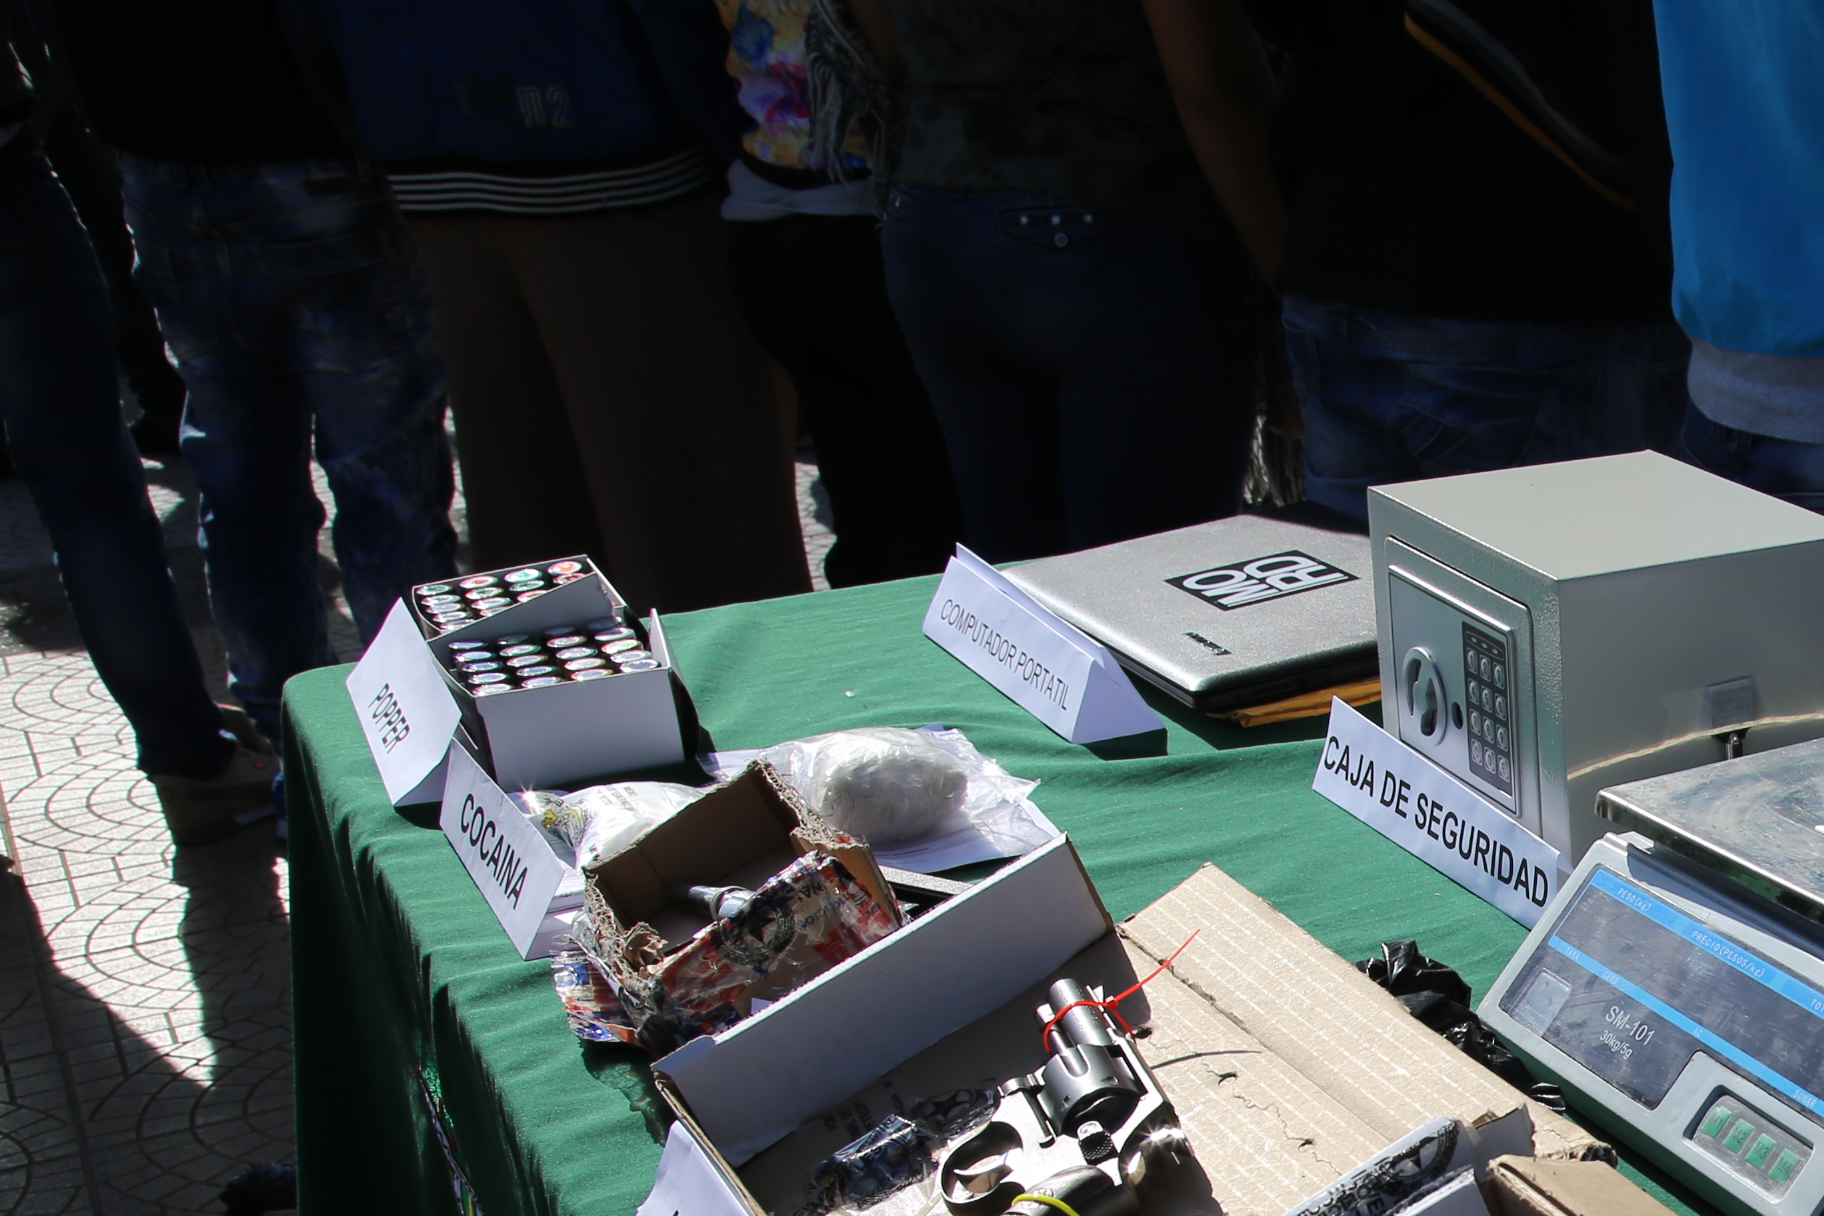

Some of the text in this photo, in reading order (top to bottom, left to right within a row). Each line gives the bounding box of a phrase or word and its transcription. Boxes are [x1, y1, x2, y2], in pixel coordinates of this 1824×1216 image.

[940, 598, 1070, 712] COMPUTADOR PORTATIL
[368, 682, 411, 755] POPPER
[460, 792, 529, 911] COCAINA
[1323, 735, 1549, 908] CAJA DE SEGURIDAD
[1616, 886, 1653, 912] PESO(kg)
[1691, 930, 1767, 978] PRECIO(PESOS/kg)
[1599, 1029, 1634, 1061] 30kg/5g
[1604, 1004, 1656, 1047] SM-101
